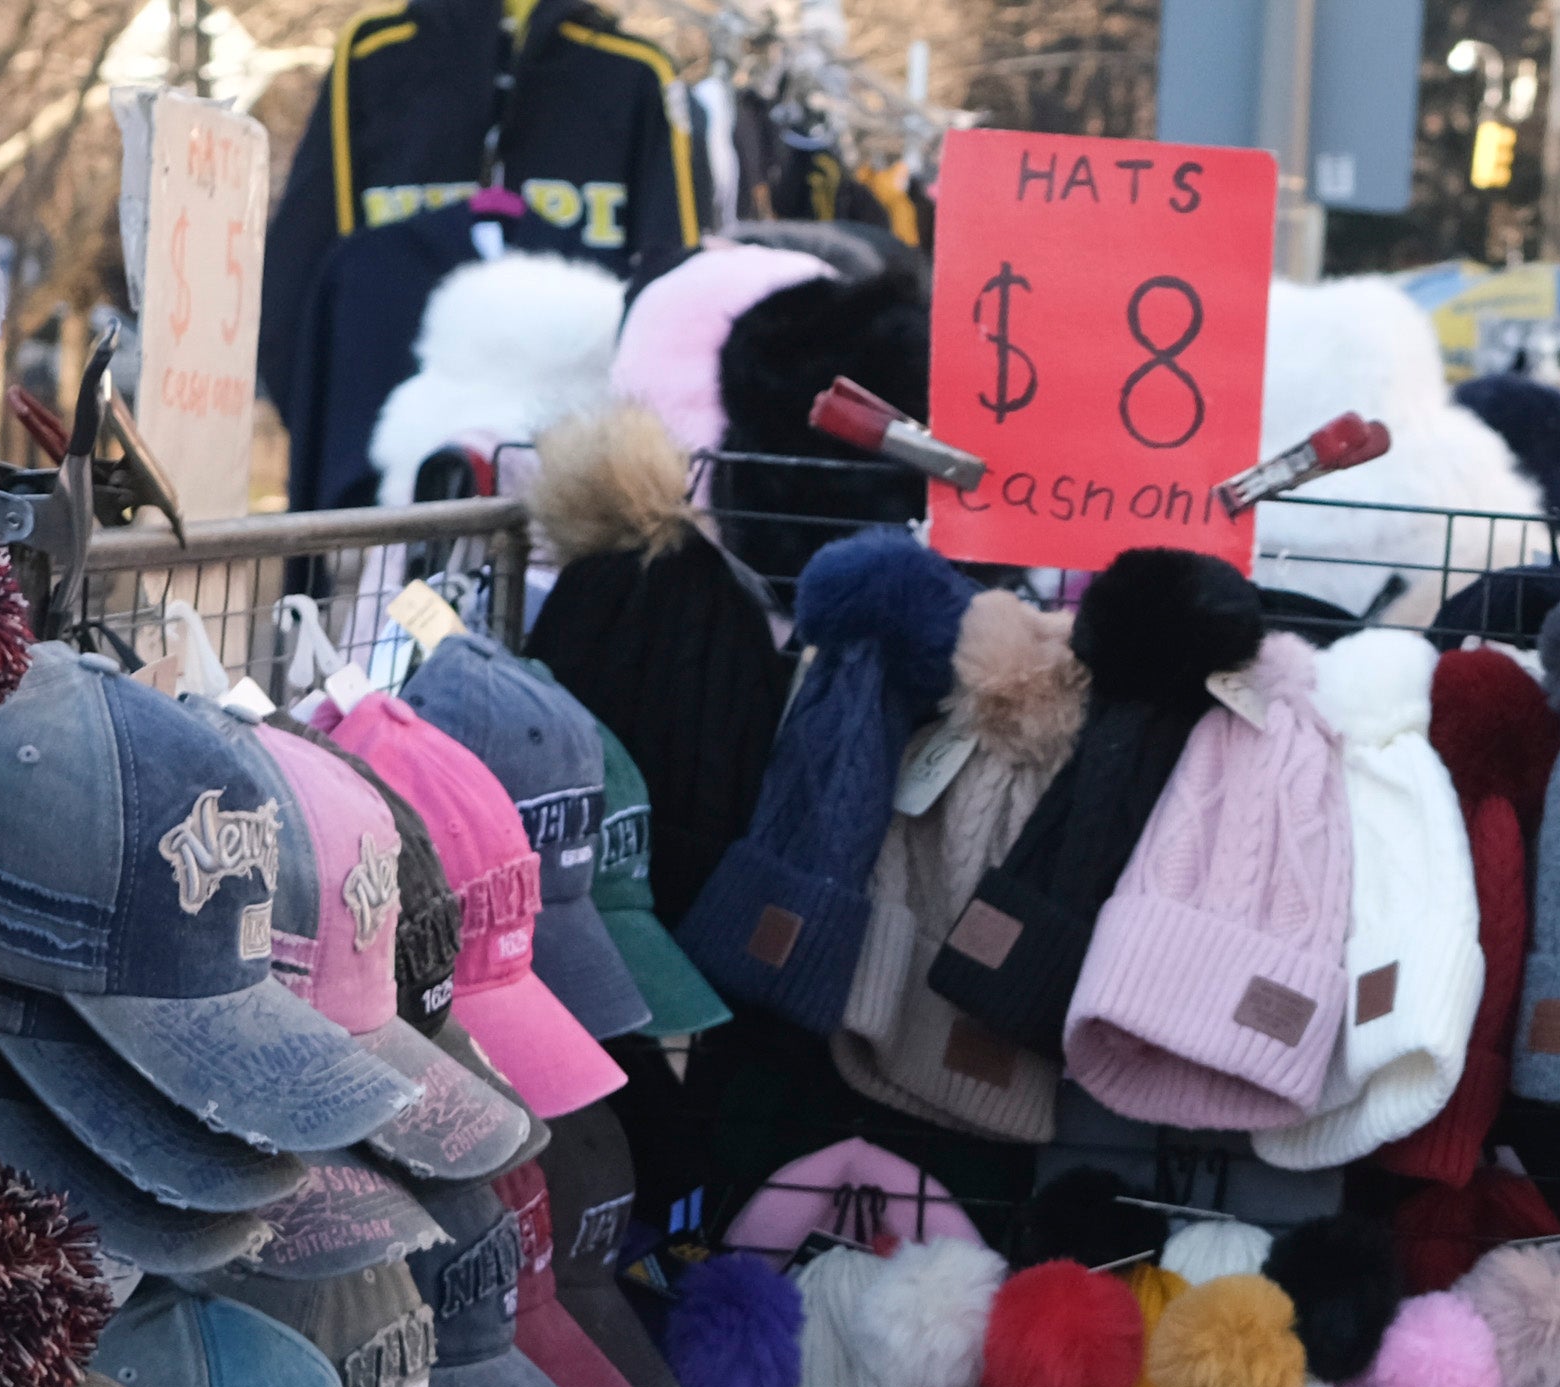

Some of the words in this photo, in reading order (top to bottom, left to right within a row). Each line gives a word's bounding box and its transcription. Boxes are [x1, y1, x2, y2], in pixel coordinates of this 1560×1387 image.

[1017, 150, 1204, 213] HATS
[972, 261, 1038, 424] $
[1118, 275, 1206, 449] 8
